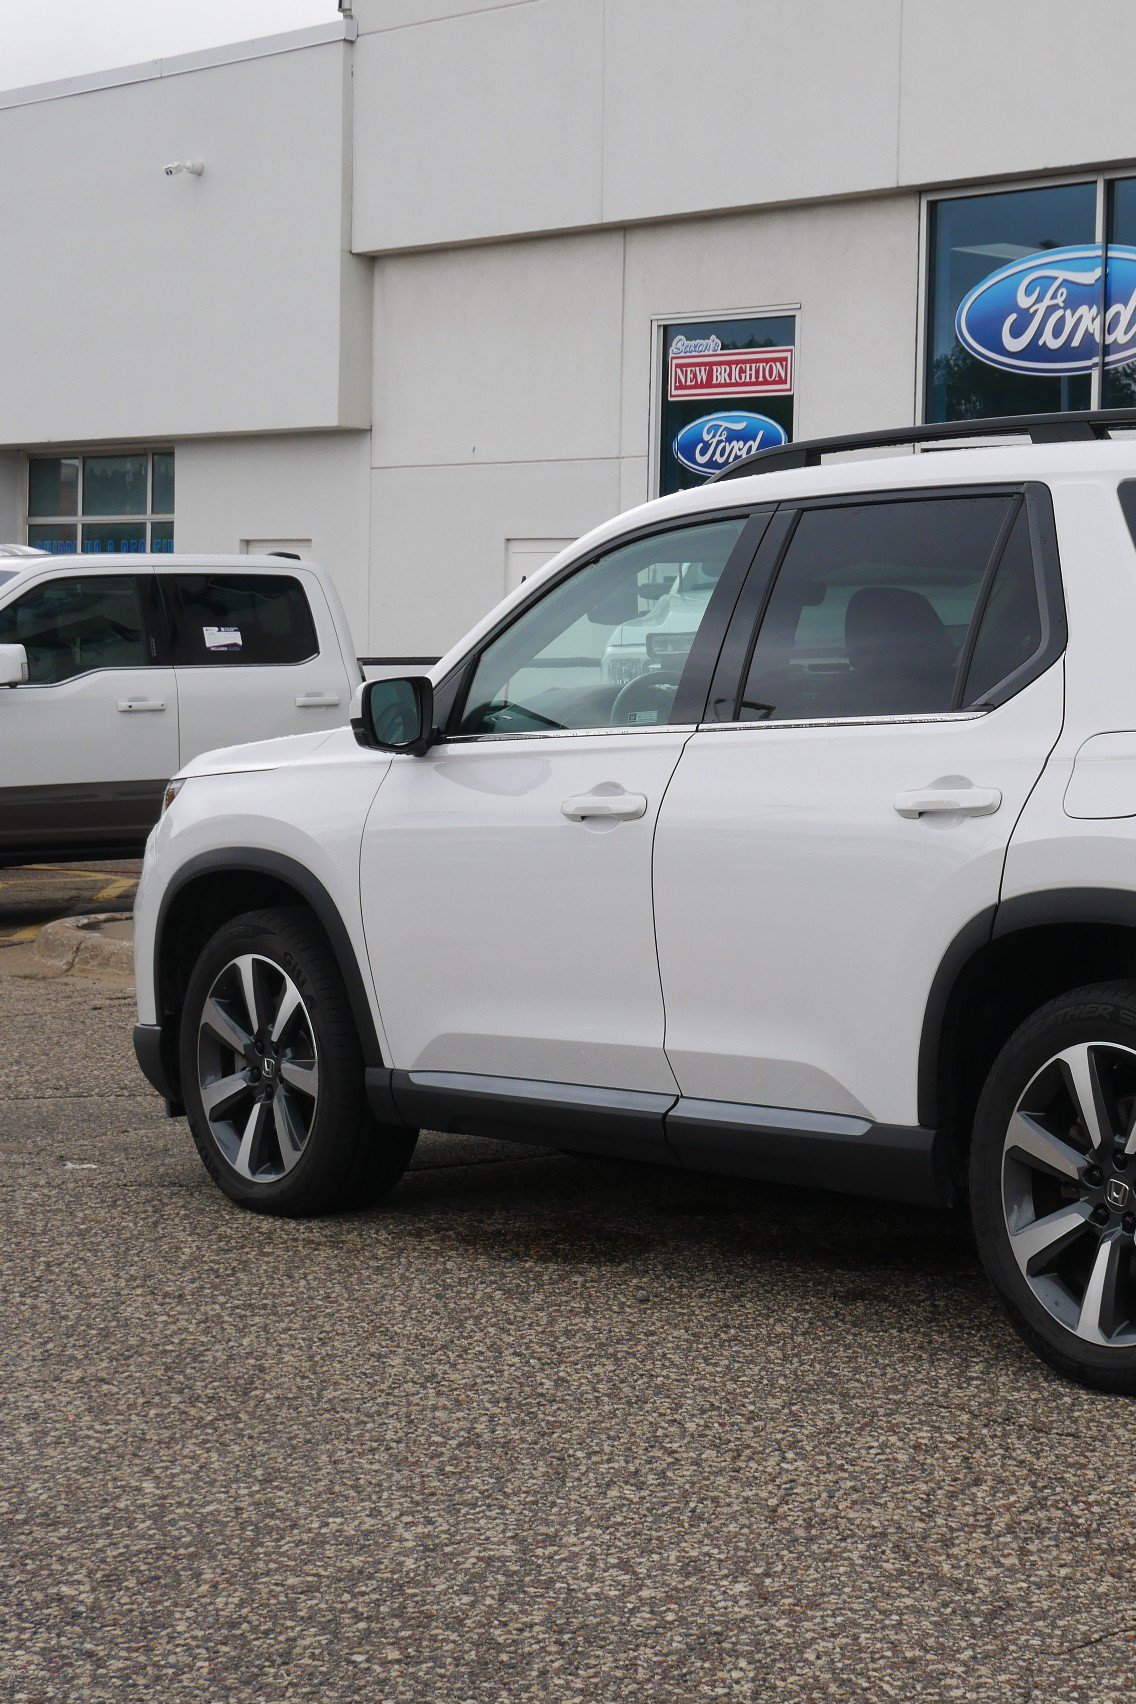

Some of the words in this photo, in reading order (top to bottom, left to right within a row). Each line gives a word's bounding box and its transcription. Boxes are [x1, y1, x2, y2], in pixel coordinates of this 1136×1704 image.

[671, 336, 720, 355] Saxon's
[676, 366, 709, 386] NEW
[712, 361, 786, 384] BRIGHTON
[695, 421, 764, 464] Ford
